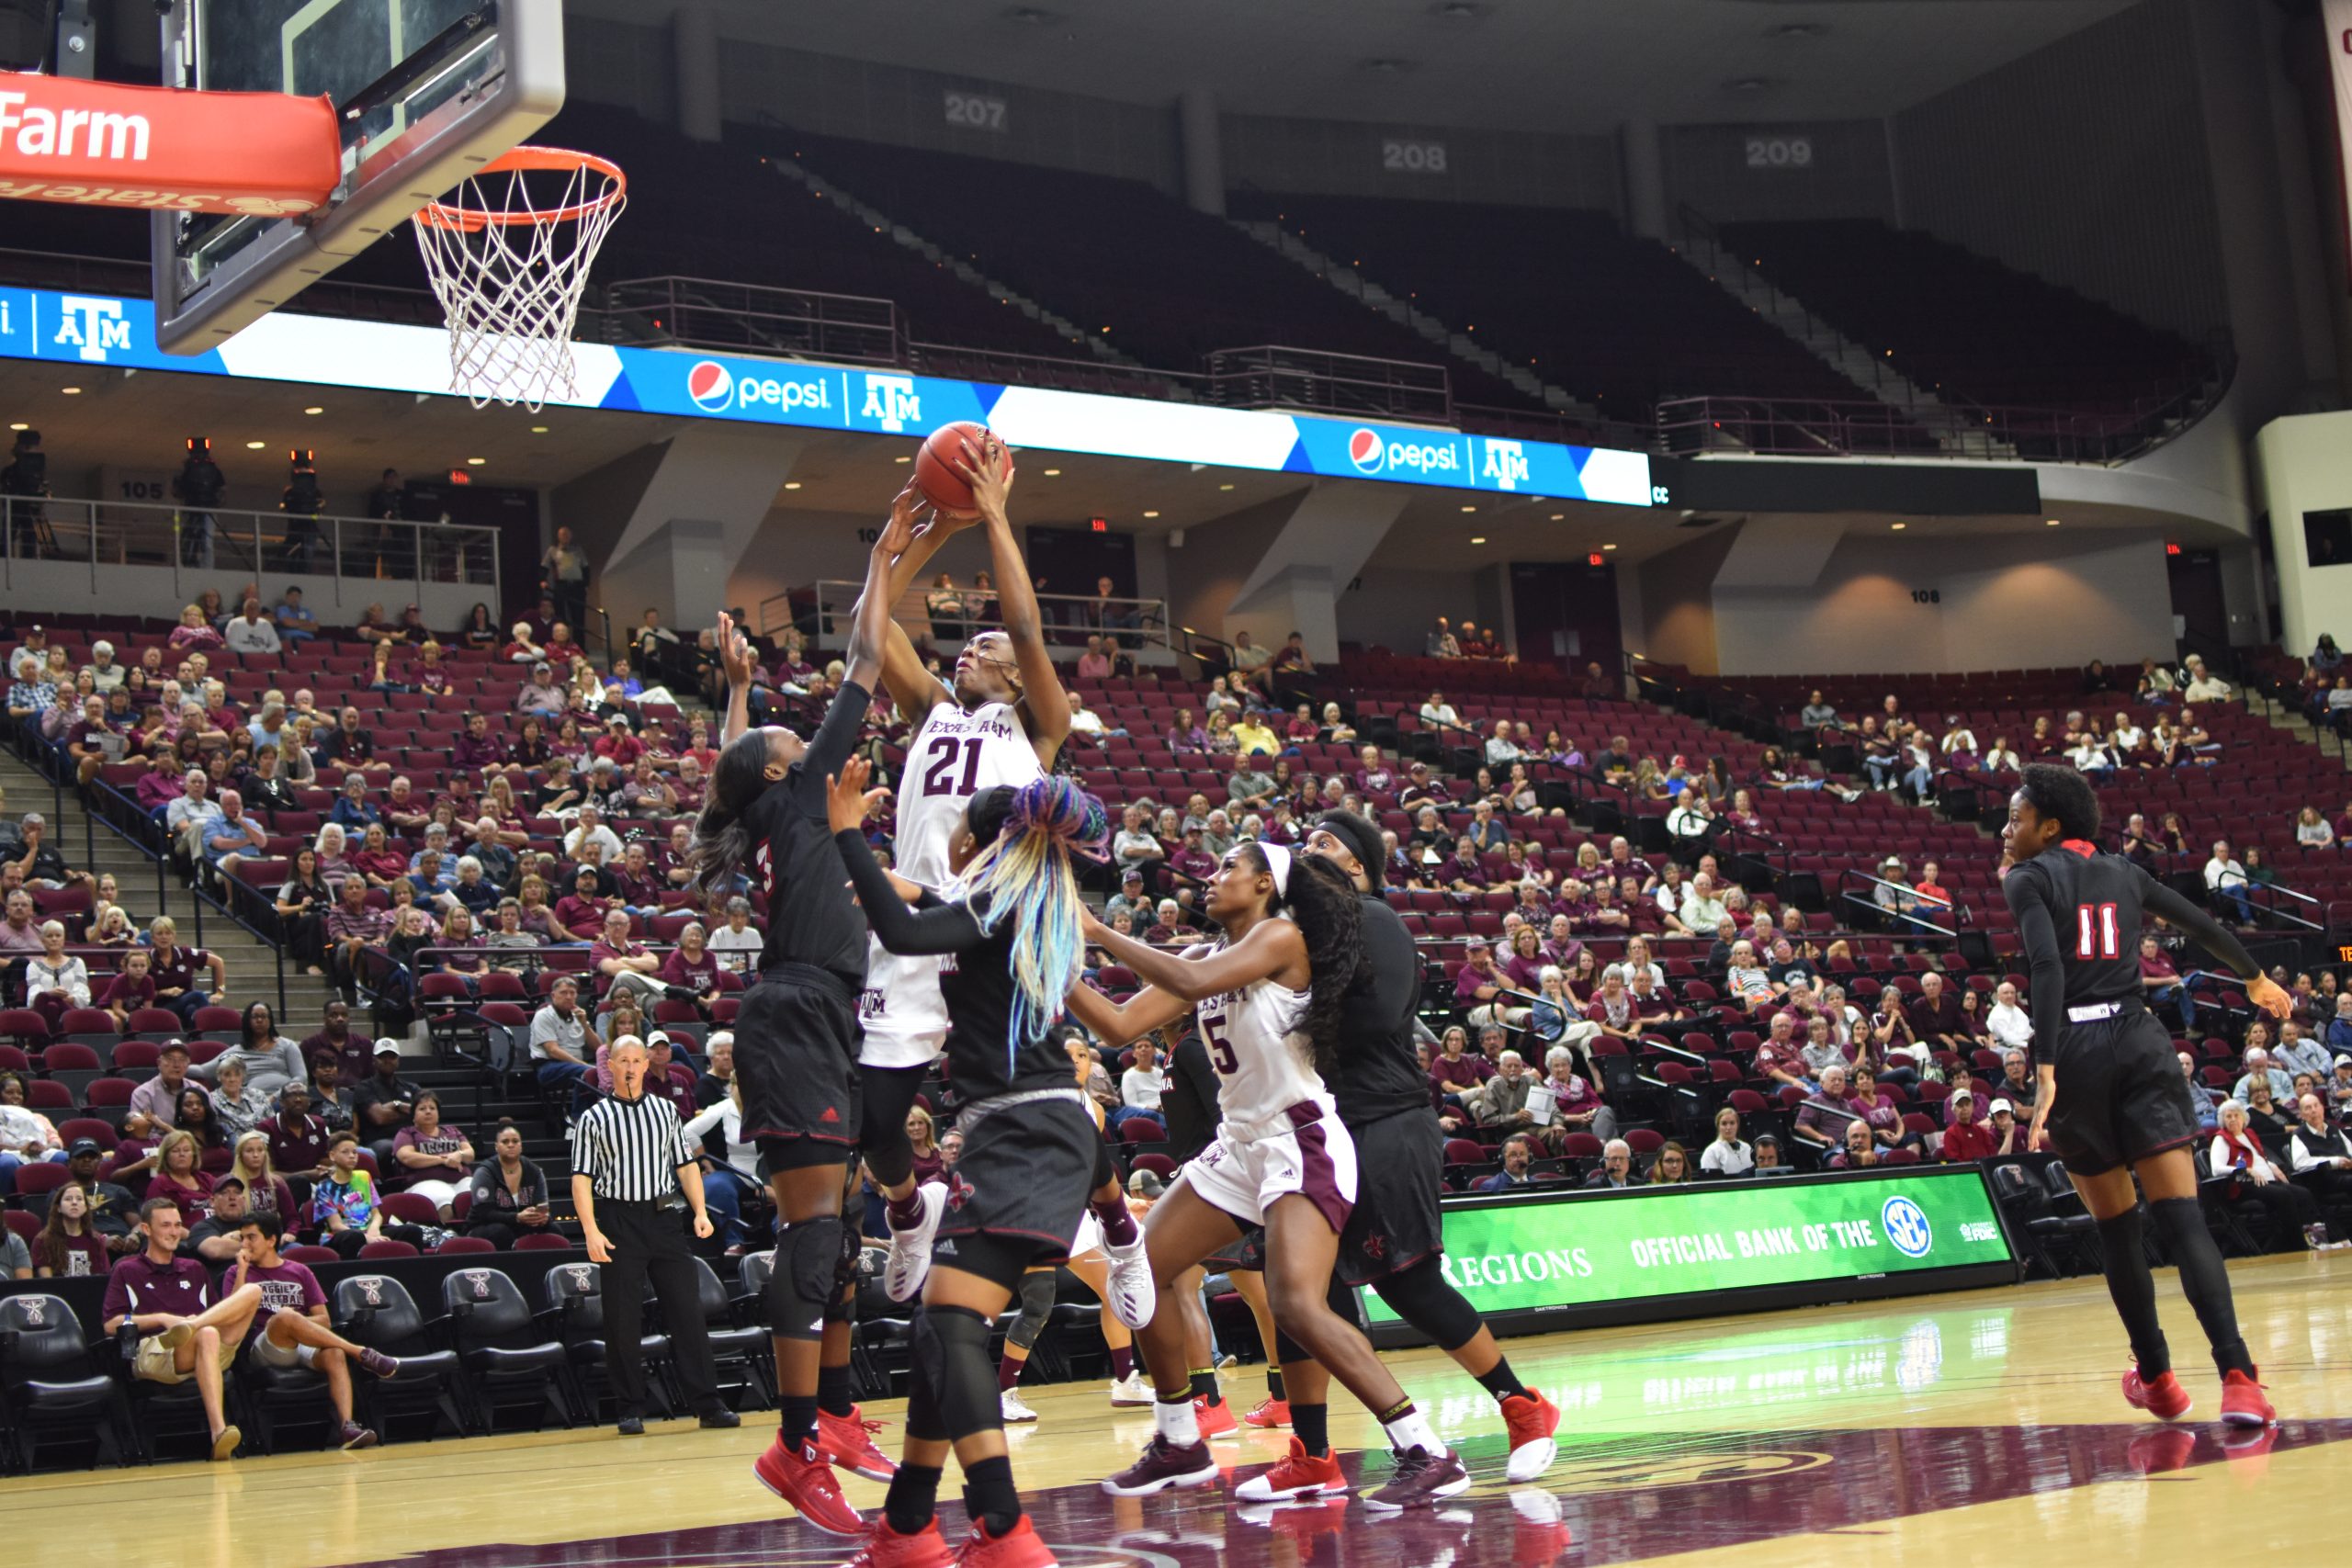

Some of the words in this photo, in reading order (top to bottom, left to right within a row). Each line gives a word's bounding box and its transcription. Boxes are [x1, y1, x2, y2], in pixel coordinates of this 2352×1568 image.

[944, 95, 1005, 129] 207
[1383, 143, 1447, 171] 208
[1747, 140, 1812, 165] 209
[739, 378, 831, 412] pepsi
[1388, 442, 1460, 474] pepsi
[120, 481, 164, 499] 105
[1653, 486, 1668, 503] CC
[1911, 590, 1940, 604] 108
[922, 736, 984, 796] 21
[2076, 903, 2120, 960] 11
[1203, 1014, 1238, 1074] 5
[1631, 1234, 1734, 1268] OFFICIAL
[1735, 1226, 1801, 1258] BANK
[1802, 1223, 1830, 1252] OF
[1830, 1219, 1878, 1249] THE
[1884, 1201, 1928, 1252] SEC
